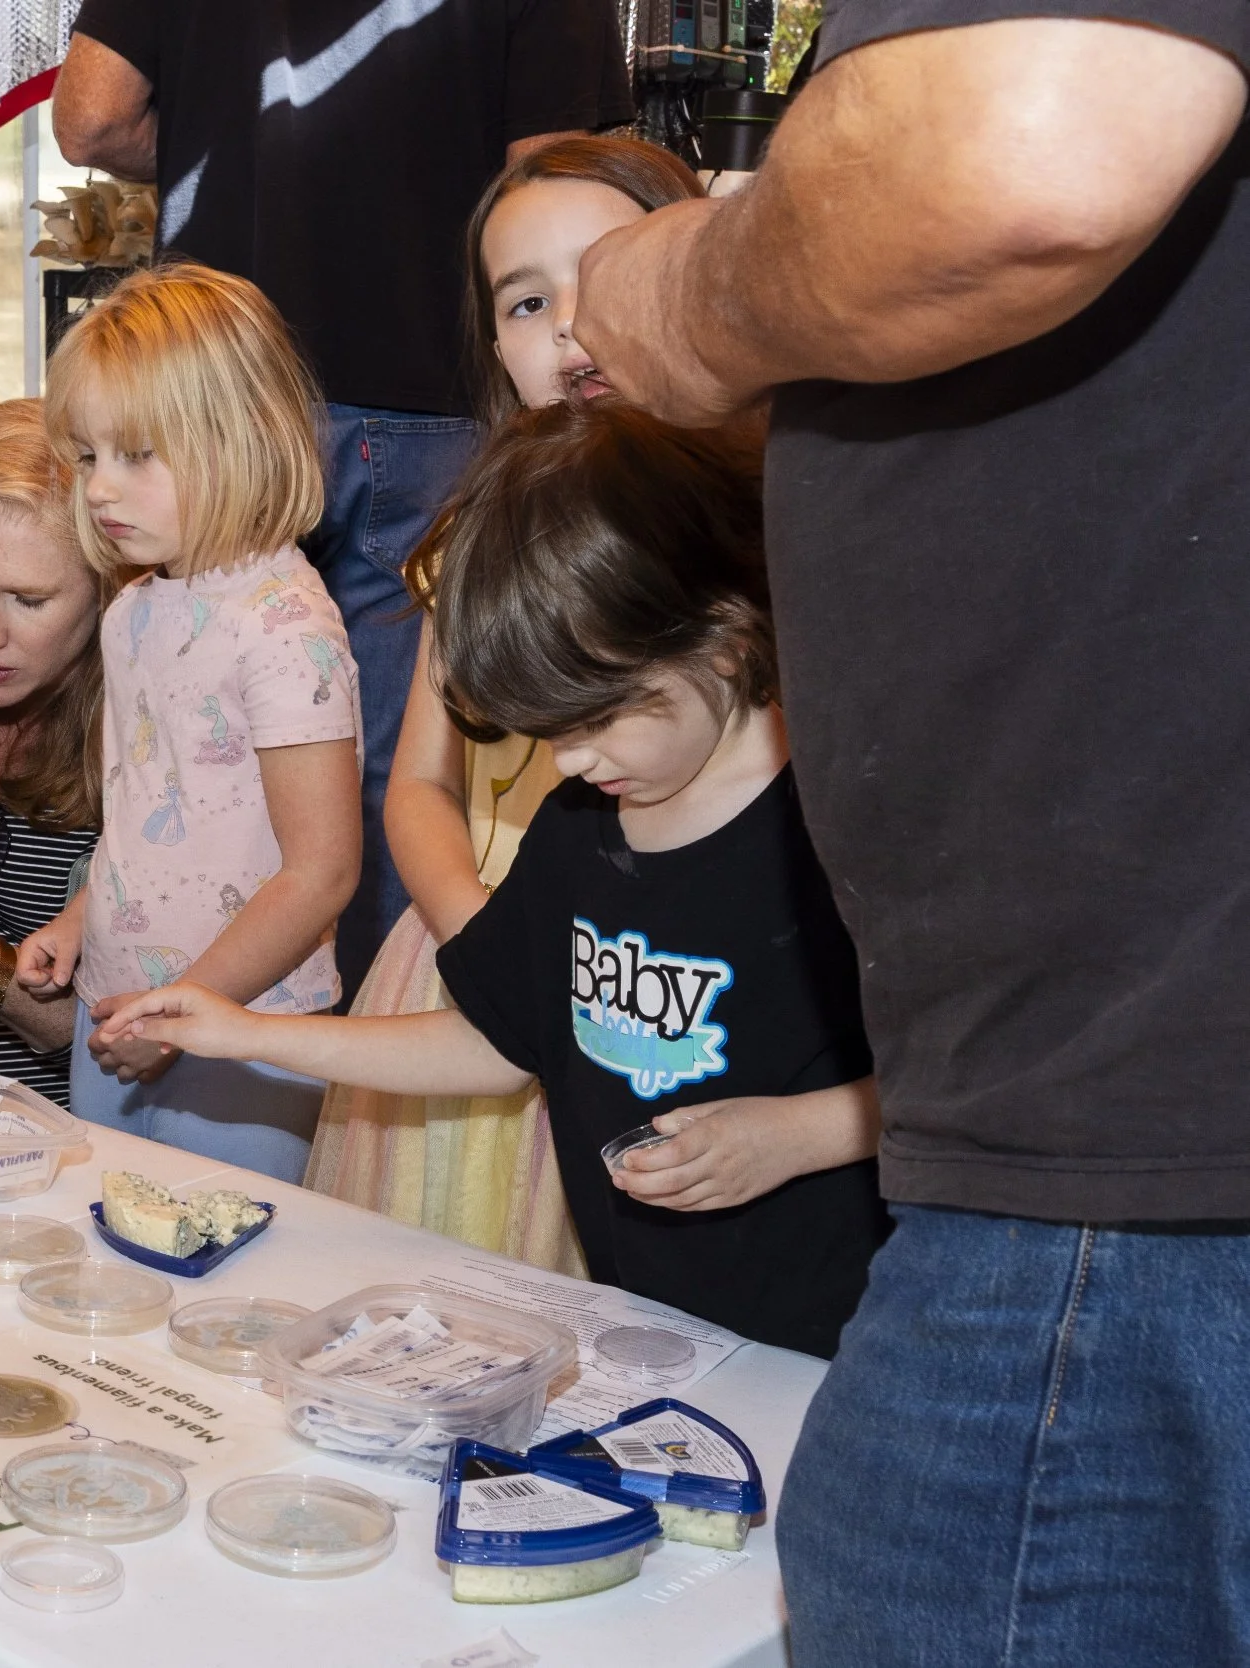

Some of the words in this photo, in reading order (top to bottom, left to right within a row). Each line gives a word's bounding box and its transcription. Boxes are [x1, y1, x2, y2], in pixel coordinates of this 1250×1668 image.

[571, 925, 722, 1042] Baby
[33, 1353, 146, 1409] filamentous
[146, 1405, 164, 1414] a
[150, 1386, 224, 1420] fungal
[163, 1413, 225, 1444] Make
